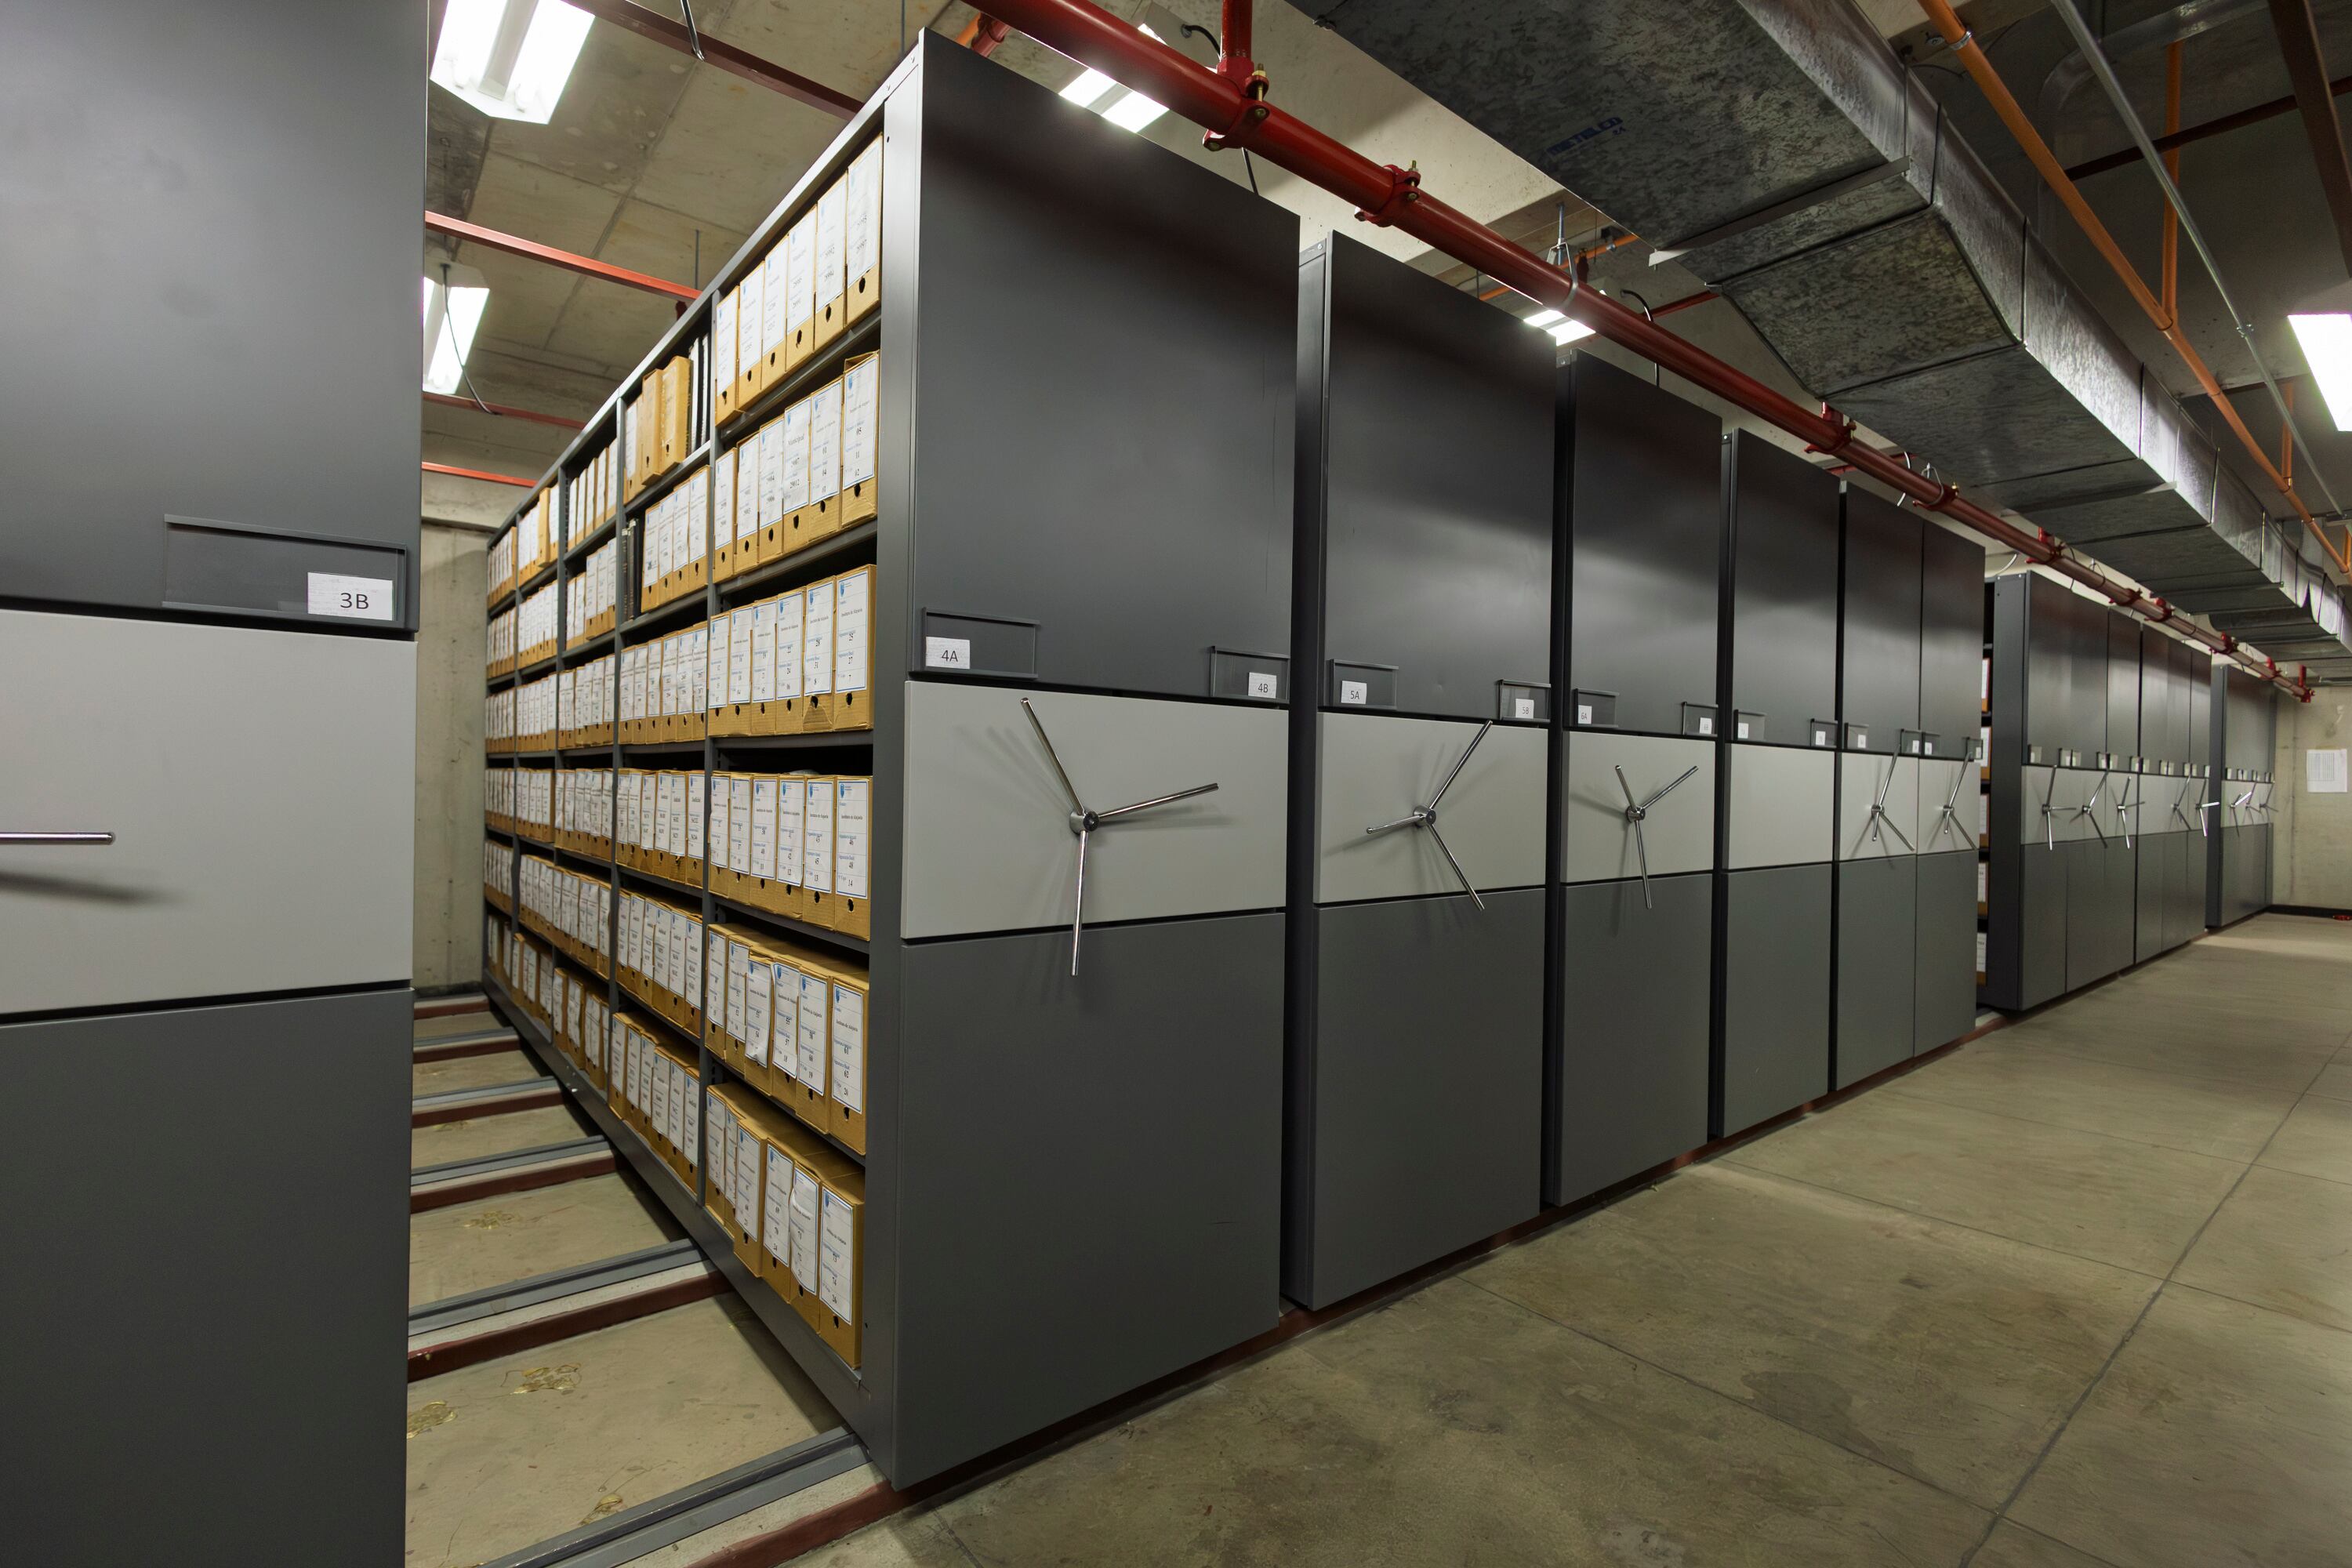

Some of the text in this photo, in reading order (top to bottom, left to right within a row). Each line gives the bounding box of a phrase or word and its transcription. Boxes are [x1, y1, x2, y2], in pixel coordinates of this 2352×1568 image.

[340, 593, 369, 610] 3B
[941, 650, 958, 662] 4A
[1258, 683, 1269, 693] 4B
[1350, 691, 1360, 700] 5A
[1522, 706, 1530, 715] 5B
